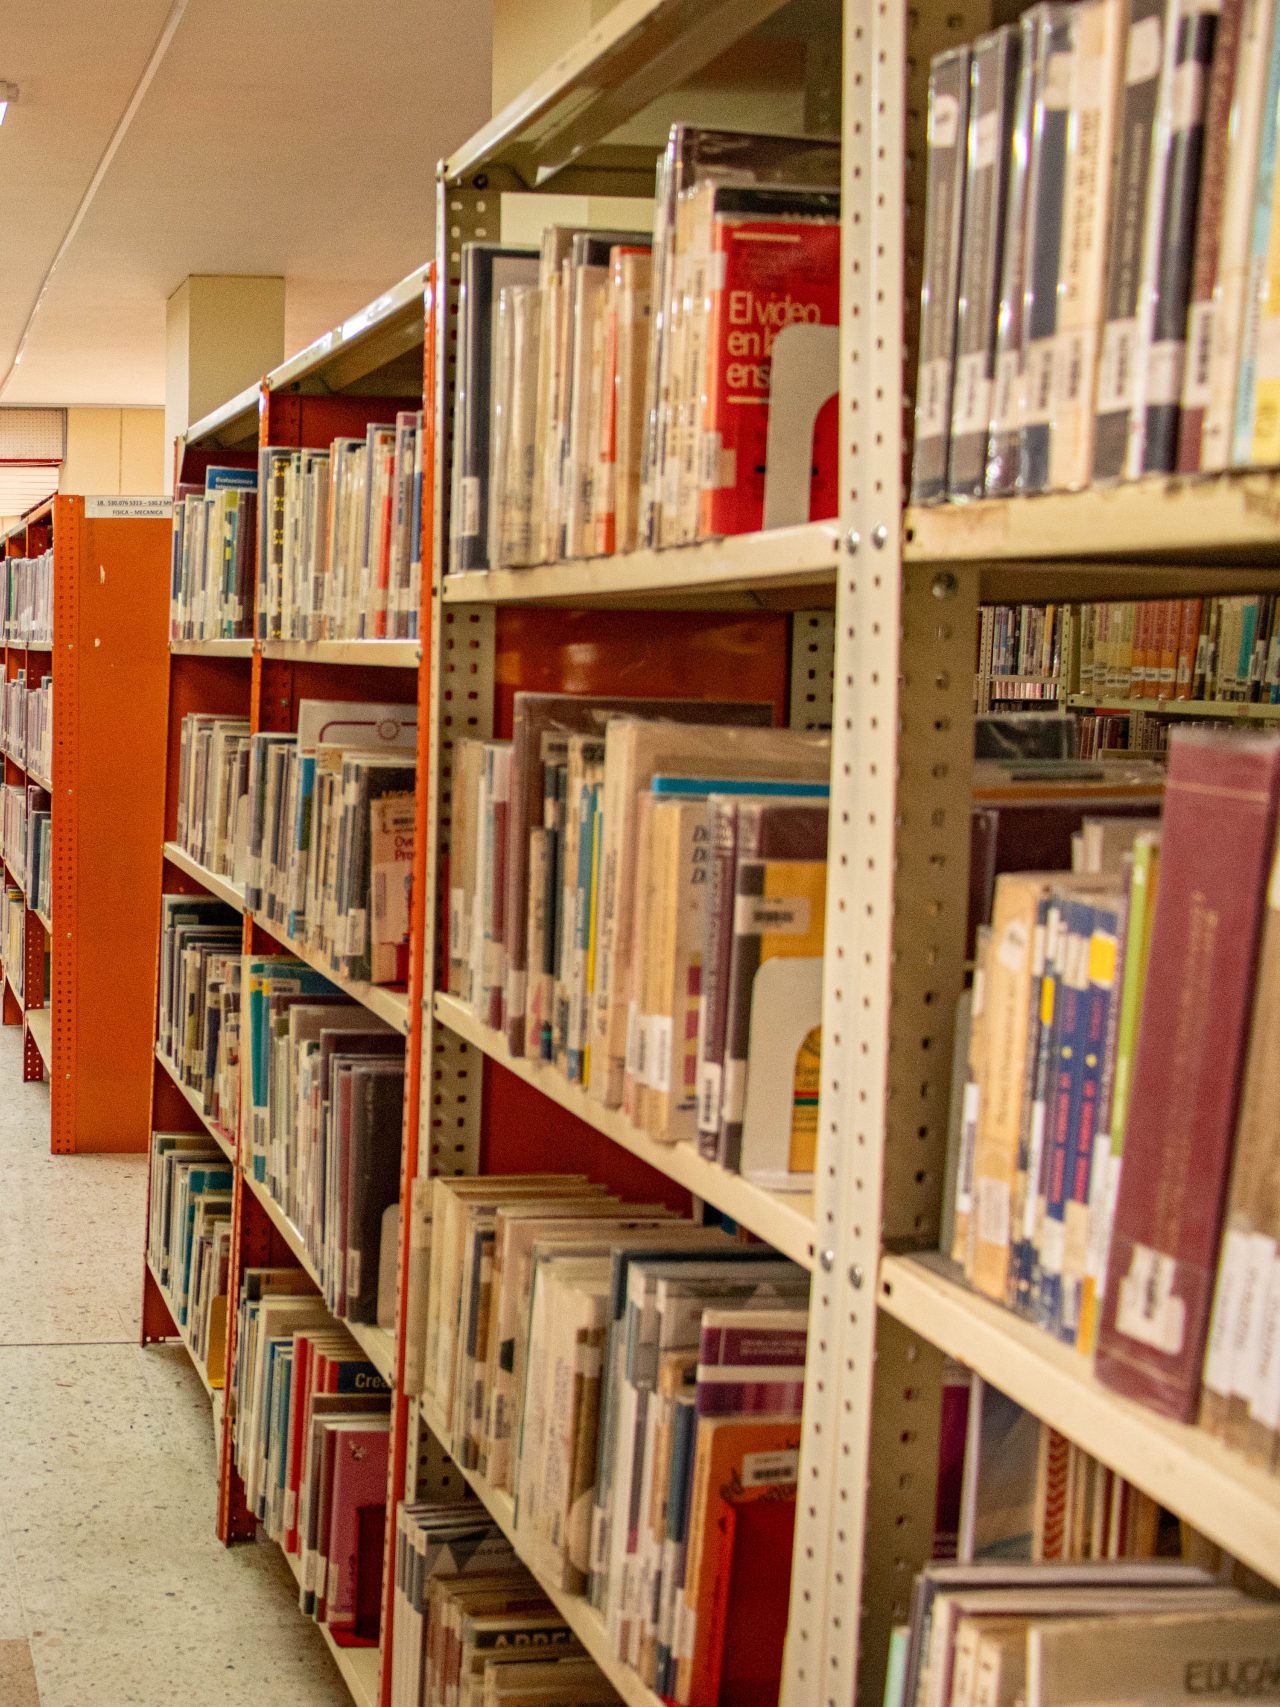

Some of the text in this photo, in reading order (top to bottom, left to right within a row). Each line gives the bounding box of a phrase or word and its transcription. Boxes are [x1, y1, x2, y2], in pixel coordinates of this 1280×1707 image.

[729, 290, 821, 326] El video
[727, 330, 761, 357] en
